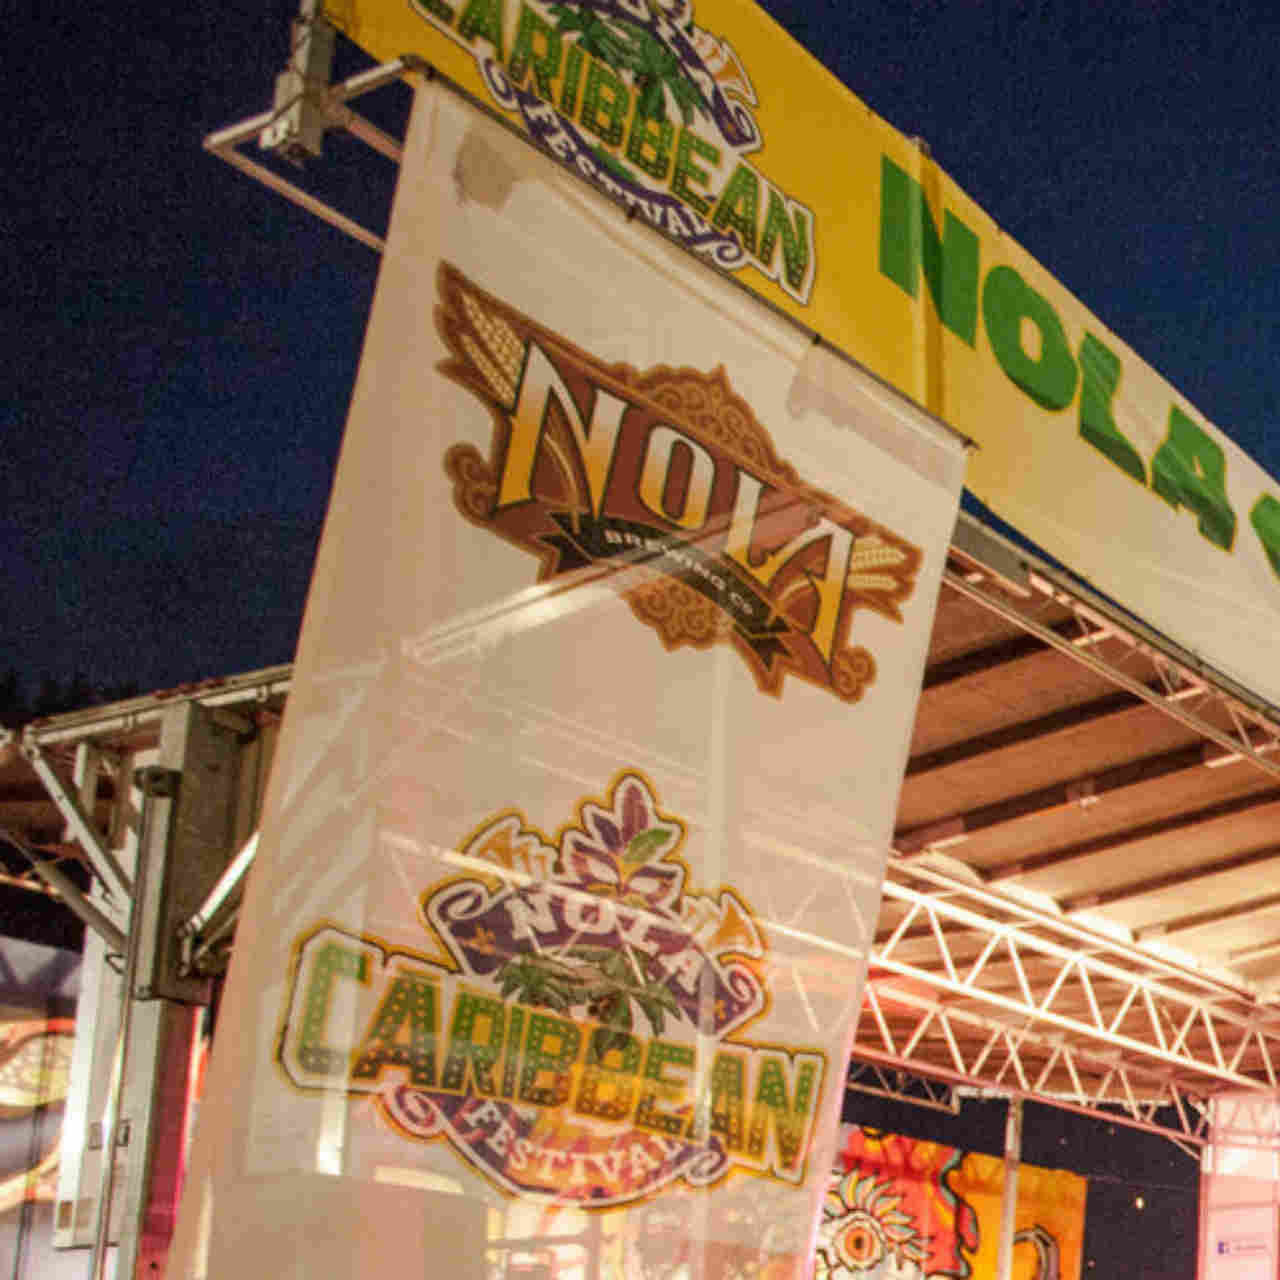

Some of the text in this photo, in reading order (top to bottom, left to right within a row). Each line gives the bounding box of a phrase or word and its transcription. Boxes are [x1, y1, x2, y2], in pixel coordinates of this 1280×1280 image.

[878, 152, 1238, 553] NOLA
[496, 334, 858, 674] NOLA
[295, 940, 822, 1172] CARIBBEAN
[509, 888, 700, 995] NOLA
[463, 1099, 684, 1185] FESTIVAL
